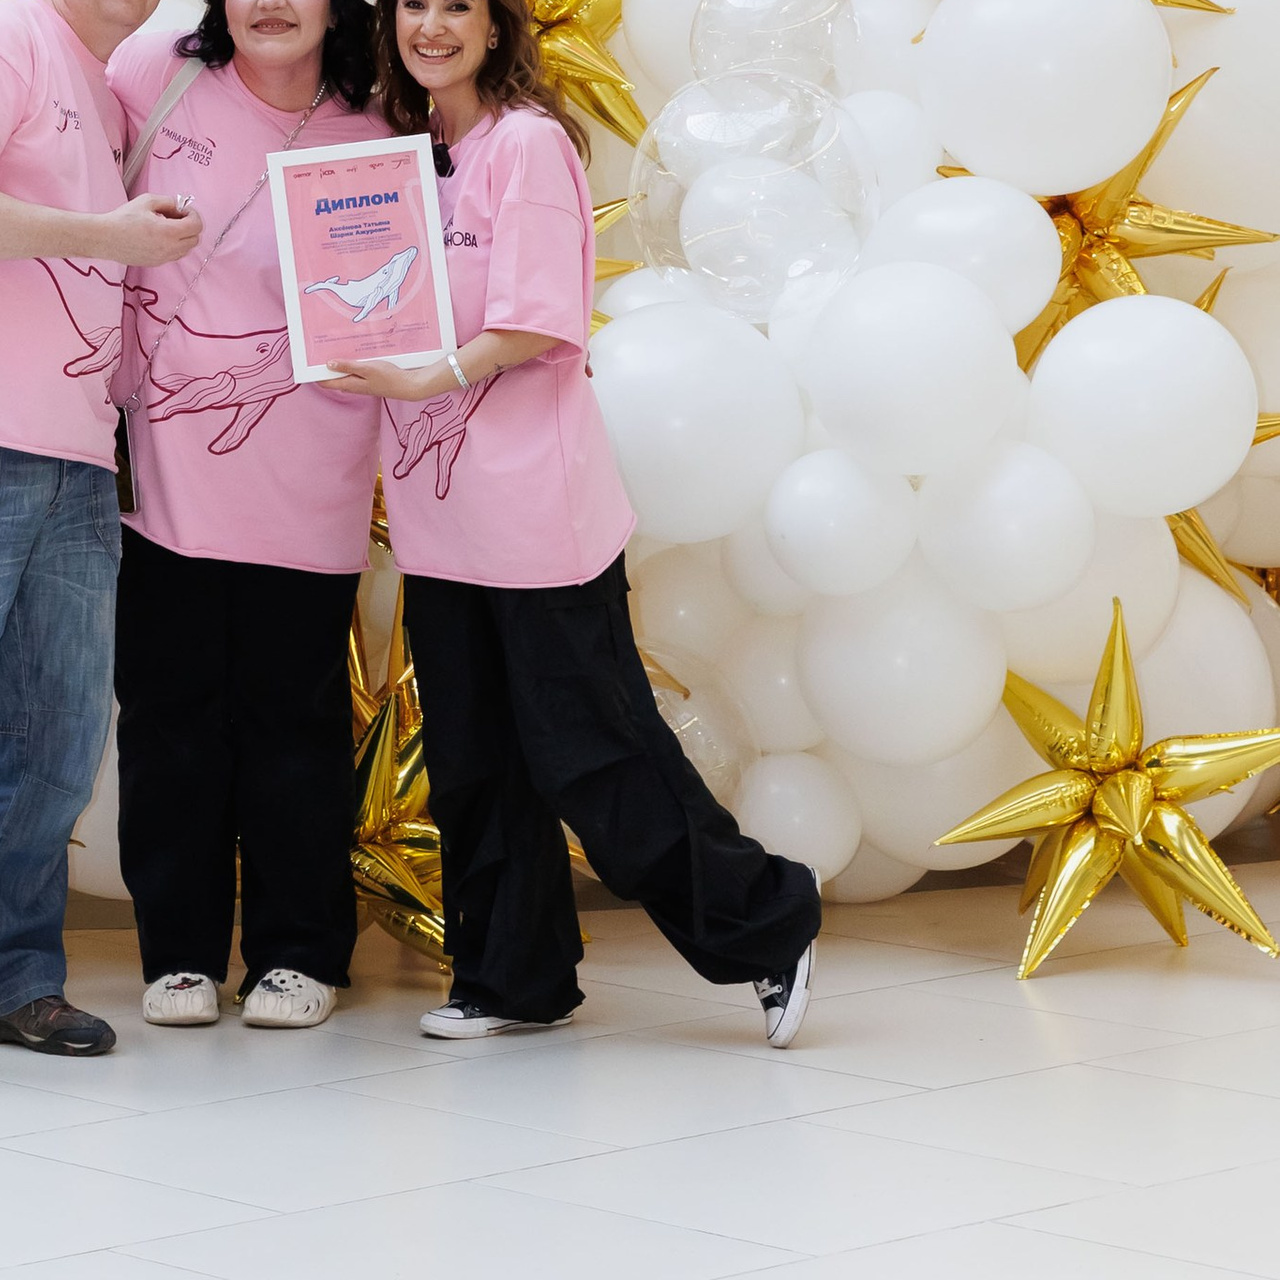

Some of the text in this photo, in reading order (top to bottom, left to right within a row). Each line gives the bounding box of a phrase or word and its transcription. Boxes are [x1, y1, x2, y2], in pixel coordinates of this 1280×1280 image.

[160, 127, 213, 157] УМНАЯ ВЕСНА
[187, 150, 211, 167] 2025
[315, 191, 399, 215] Диплом
